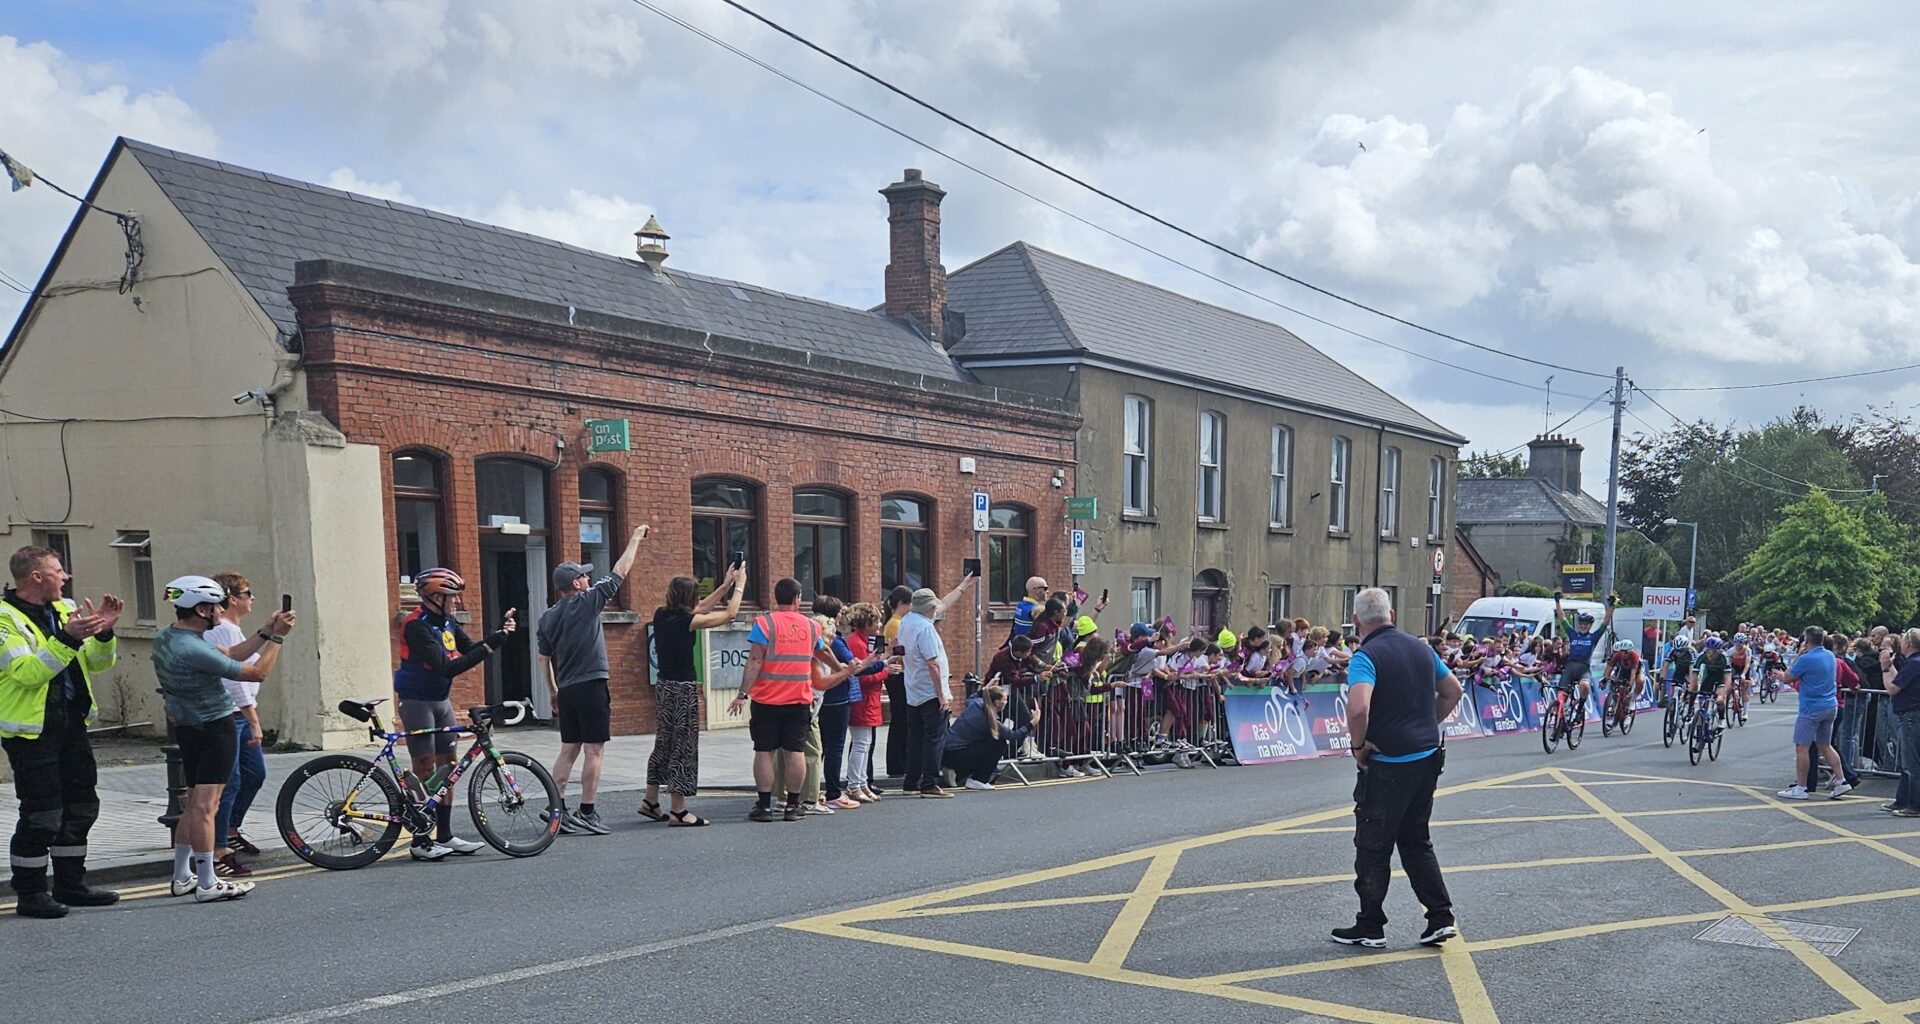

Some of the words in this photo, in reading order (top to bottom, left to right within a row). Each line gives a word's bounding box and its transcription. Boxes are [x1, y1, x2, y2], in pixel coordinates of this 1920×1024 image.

[595, 424, 610, 434] an
[595, 432, 622, 447] post
[978, 496, 985, 508] P
[1074, 532, 1082, 547] P
[1646, 594, 1681, 606] FINISH
[721, 649, 751, 668] POS
[1252, 723, 1270, 741] Rás
[1324, 717, 1340, 734] Rás
[1446, 726, 1455, 736] na
[1454, 722, 1472, 735] mBan
[1257, 743, 1270, 758] na
[1271, 740, 1297, 757] mBan
[1329, 737, 1340, 750] na
